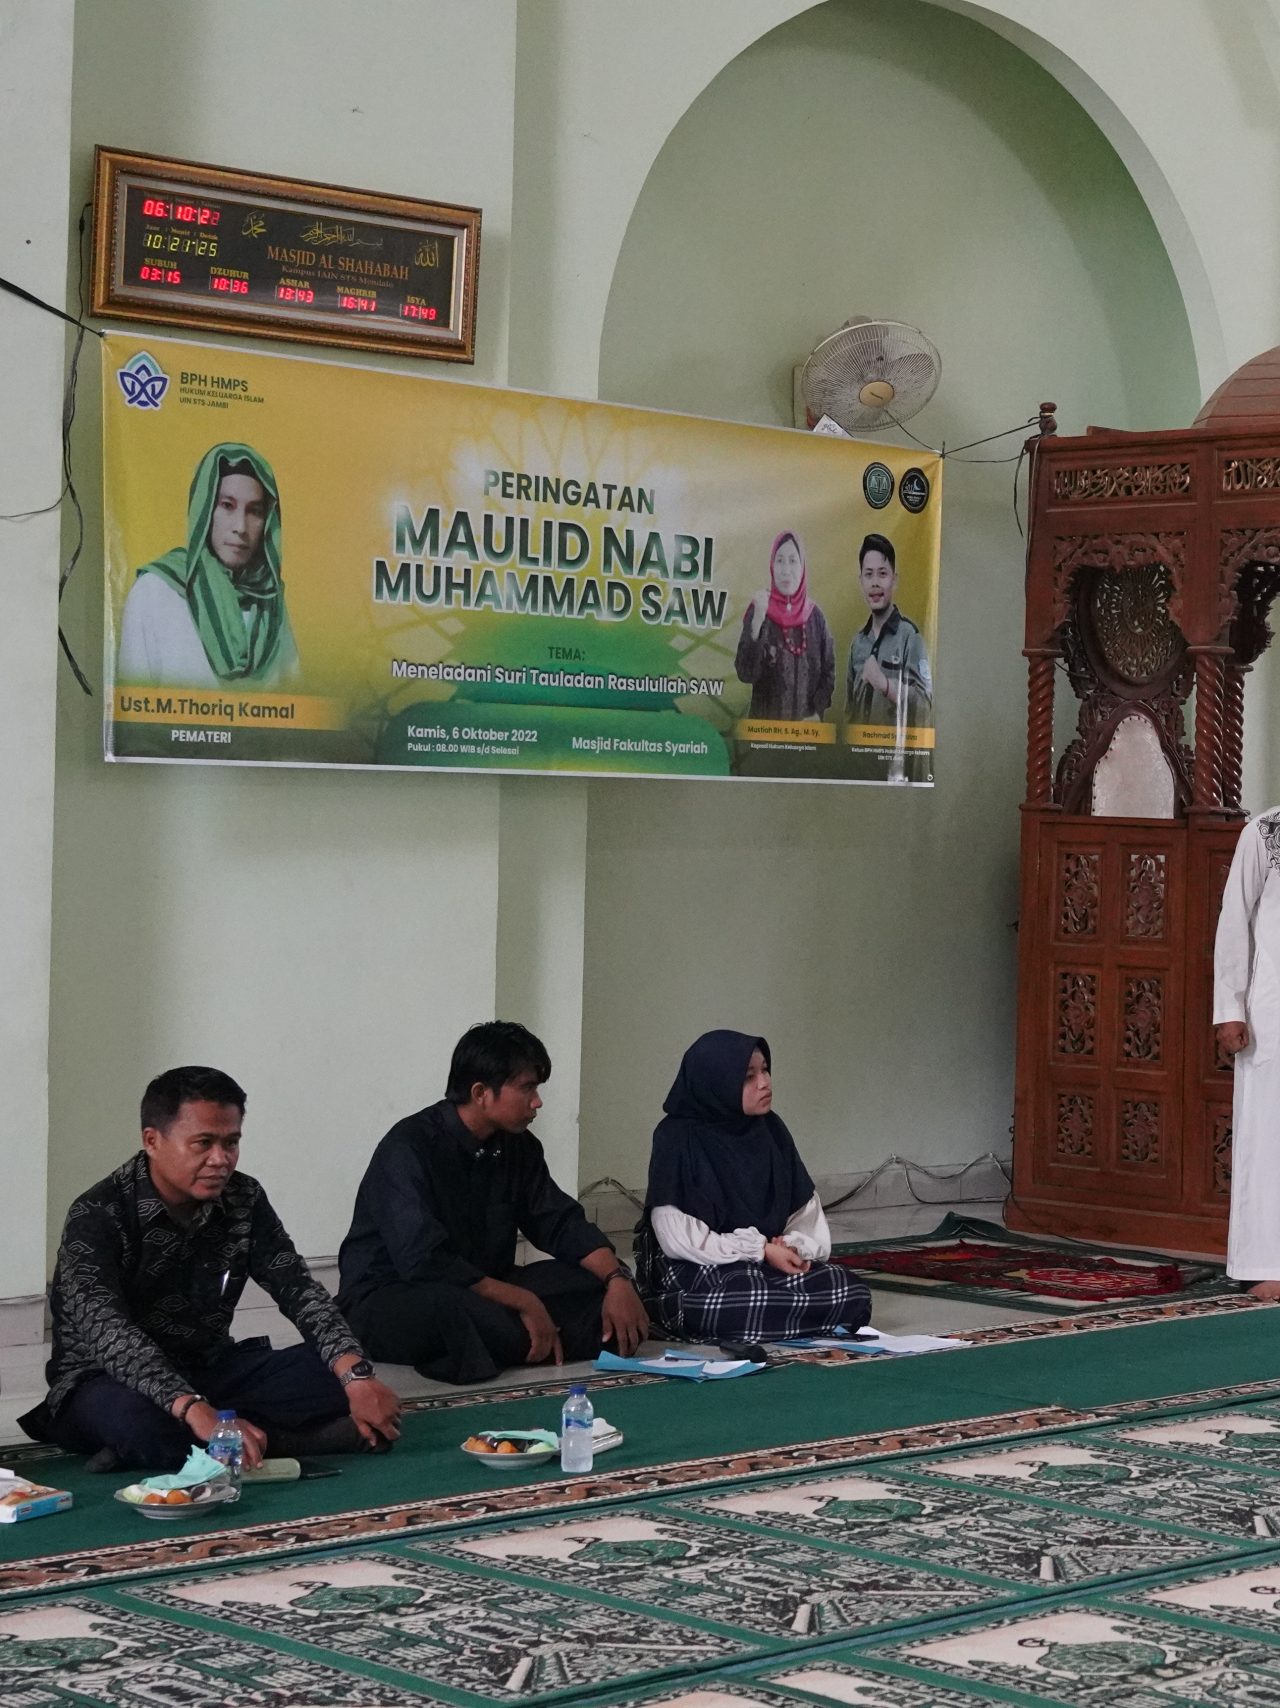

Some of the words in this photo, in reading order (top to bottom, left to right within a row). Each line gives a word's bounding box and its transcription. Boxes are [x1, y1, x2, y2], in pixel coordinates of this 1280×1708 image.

[144, 258, 177, 269] SUBUH
[267, 246, 316, 267] MASJID
[320, 253, 334, 269] AL
[338, 257, 409, 280] SHAHABAH
[210, 266, 249, 280] DZUHUR
[282, 265, 315, 278] Kampus
[279, 277, 310, 289] ASHAR
[336, 285, 377, 298] MAGHRIB
[407, 295, 426, 306] ISYA
[180, 371, 207, 387] BPH
[211, 376, 248, 392] HMPS
[180, 387, 206, 396] HUKUM
[207, 390, 242, 401] KELUARGA
[244, 395, 264, 403] ISLAM
[207, 400, 229, 409] JAMBI
[483, 469, 655, 515] PERINGATAN
[394, 505, 590, 571] MAULID
[602, 526, 713, 584] NABI
[374, 560, 632, 621] MUHAMMAD
[640, 584, 727, 628] SAW
[548, 646, 586, 662] TEMA:
[392, 660, 491, 683] Meneladani
[494, 666, 526, 685] Suri
[530, 669, 605, 689] Tauladan
[608, 674, 687, 694] Rasulullah
[690, 679, 724, 696] SAW
[238, 702, 295, 719] Kamal
[171, 730, 231, 743] PEMATERI
[407, 725, 449, 741] Kamis,
[452, 727, 459, 739] 6
[462, 727, 510, 741] Oktober
[511, 729, 538, 742] 2022
[407, 743, 431, 752] Pukul
[436, 743, 458, 753] 08.00
[460, 745, 475, 753] WIB
[476, 743, 490, 755] s/d
[572, 737, 611, 754] Masjid
[613, 738, 663, 753] Fakultas
[665, 741, 708, 756] Syariah
